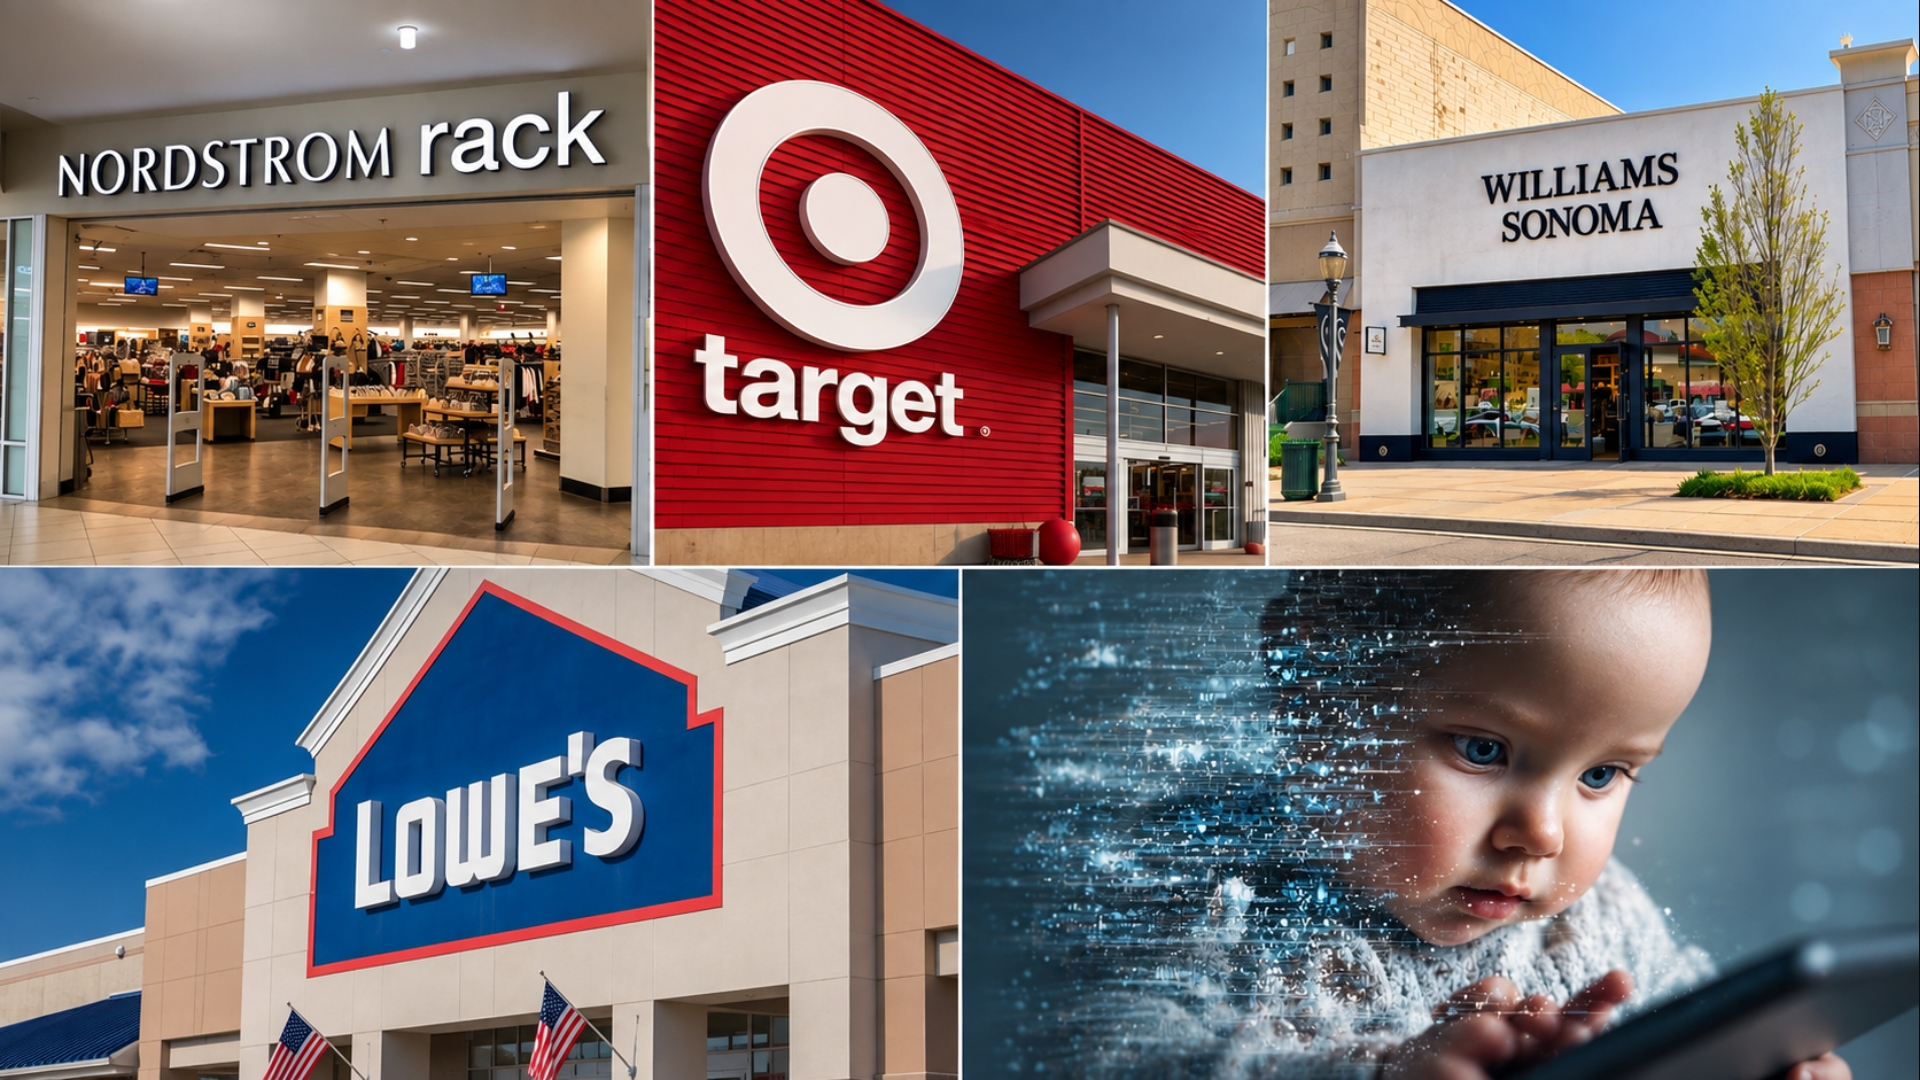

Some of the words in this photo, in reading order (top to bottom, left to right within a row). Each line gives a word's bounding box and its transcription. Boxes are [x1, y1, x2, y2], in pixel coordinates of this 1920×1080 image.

[57, 128, 394, 198] NORDSTROM
[418, 91, 607, 176] rack
[1481, 152, 1679, 205] WILLIAMS
[1501, 199, 1664, 243] SONOMA
[694, 334, 964, 447] target
[354, 731, 645, 910] LOWE'S
